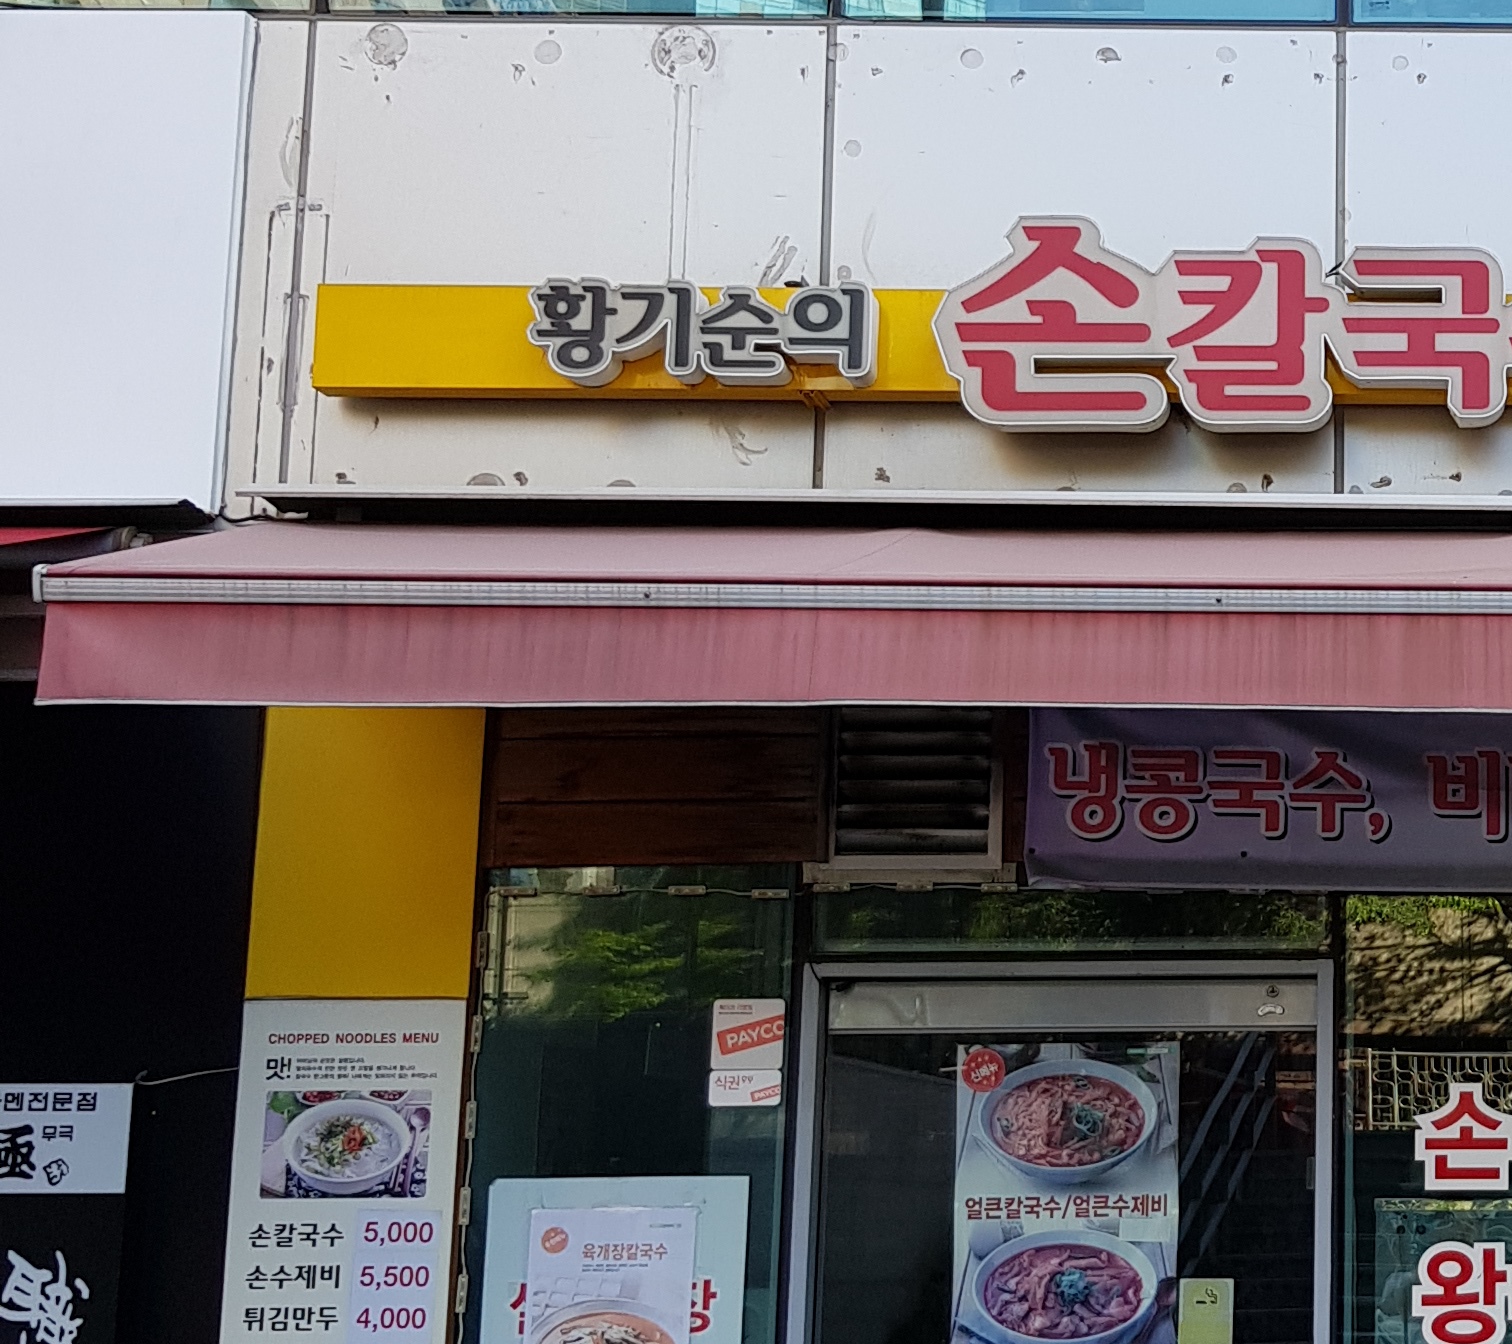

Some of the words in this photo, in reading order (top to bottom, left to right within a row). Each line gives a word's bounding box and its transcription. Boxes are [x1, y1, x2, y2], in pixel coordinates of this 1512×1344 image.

[530, 280, 876, 384] 황기순의
[1045, 742, 1388, 843] 냉콩국수,
[268, 1033, 329, 1044] CHOPPED
[336, 1032, 396, 1044] NOODLES
[402, 1032, 440, 1043] MENU
[725, 1019, 784, 1049] PAYCO
[266, 1056, 292, 1080] 맛!
[965, 1194, 1168, 1220] 얼큰칼국수/얼큰수제비
[248, 1223, 344, 1248] 손칼국수
[364, 1221, 434, 1246] 5,000
[582, 1243, 668, 1261] 육개장칼국수
[245, 1265, 341, 1290] 손수제비
[359, 1265, 430, 1290] 5,500
[242, 1307, 339, 1333] 튀김만두
[356, 1307, 426, 1332] 4,000
